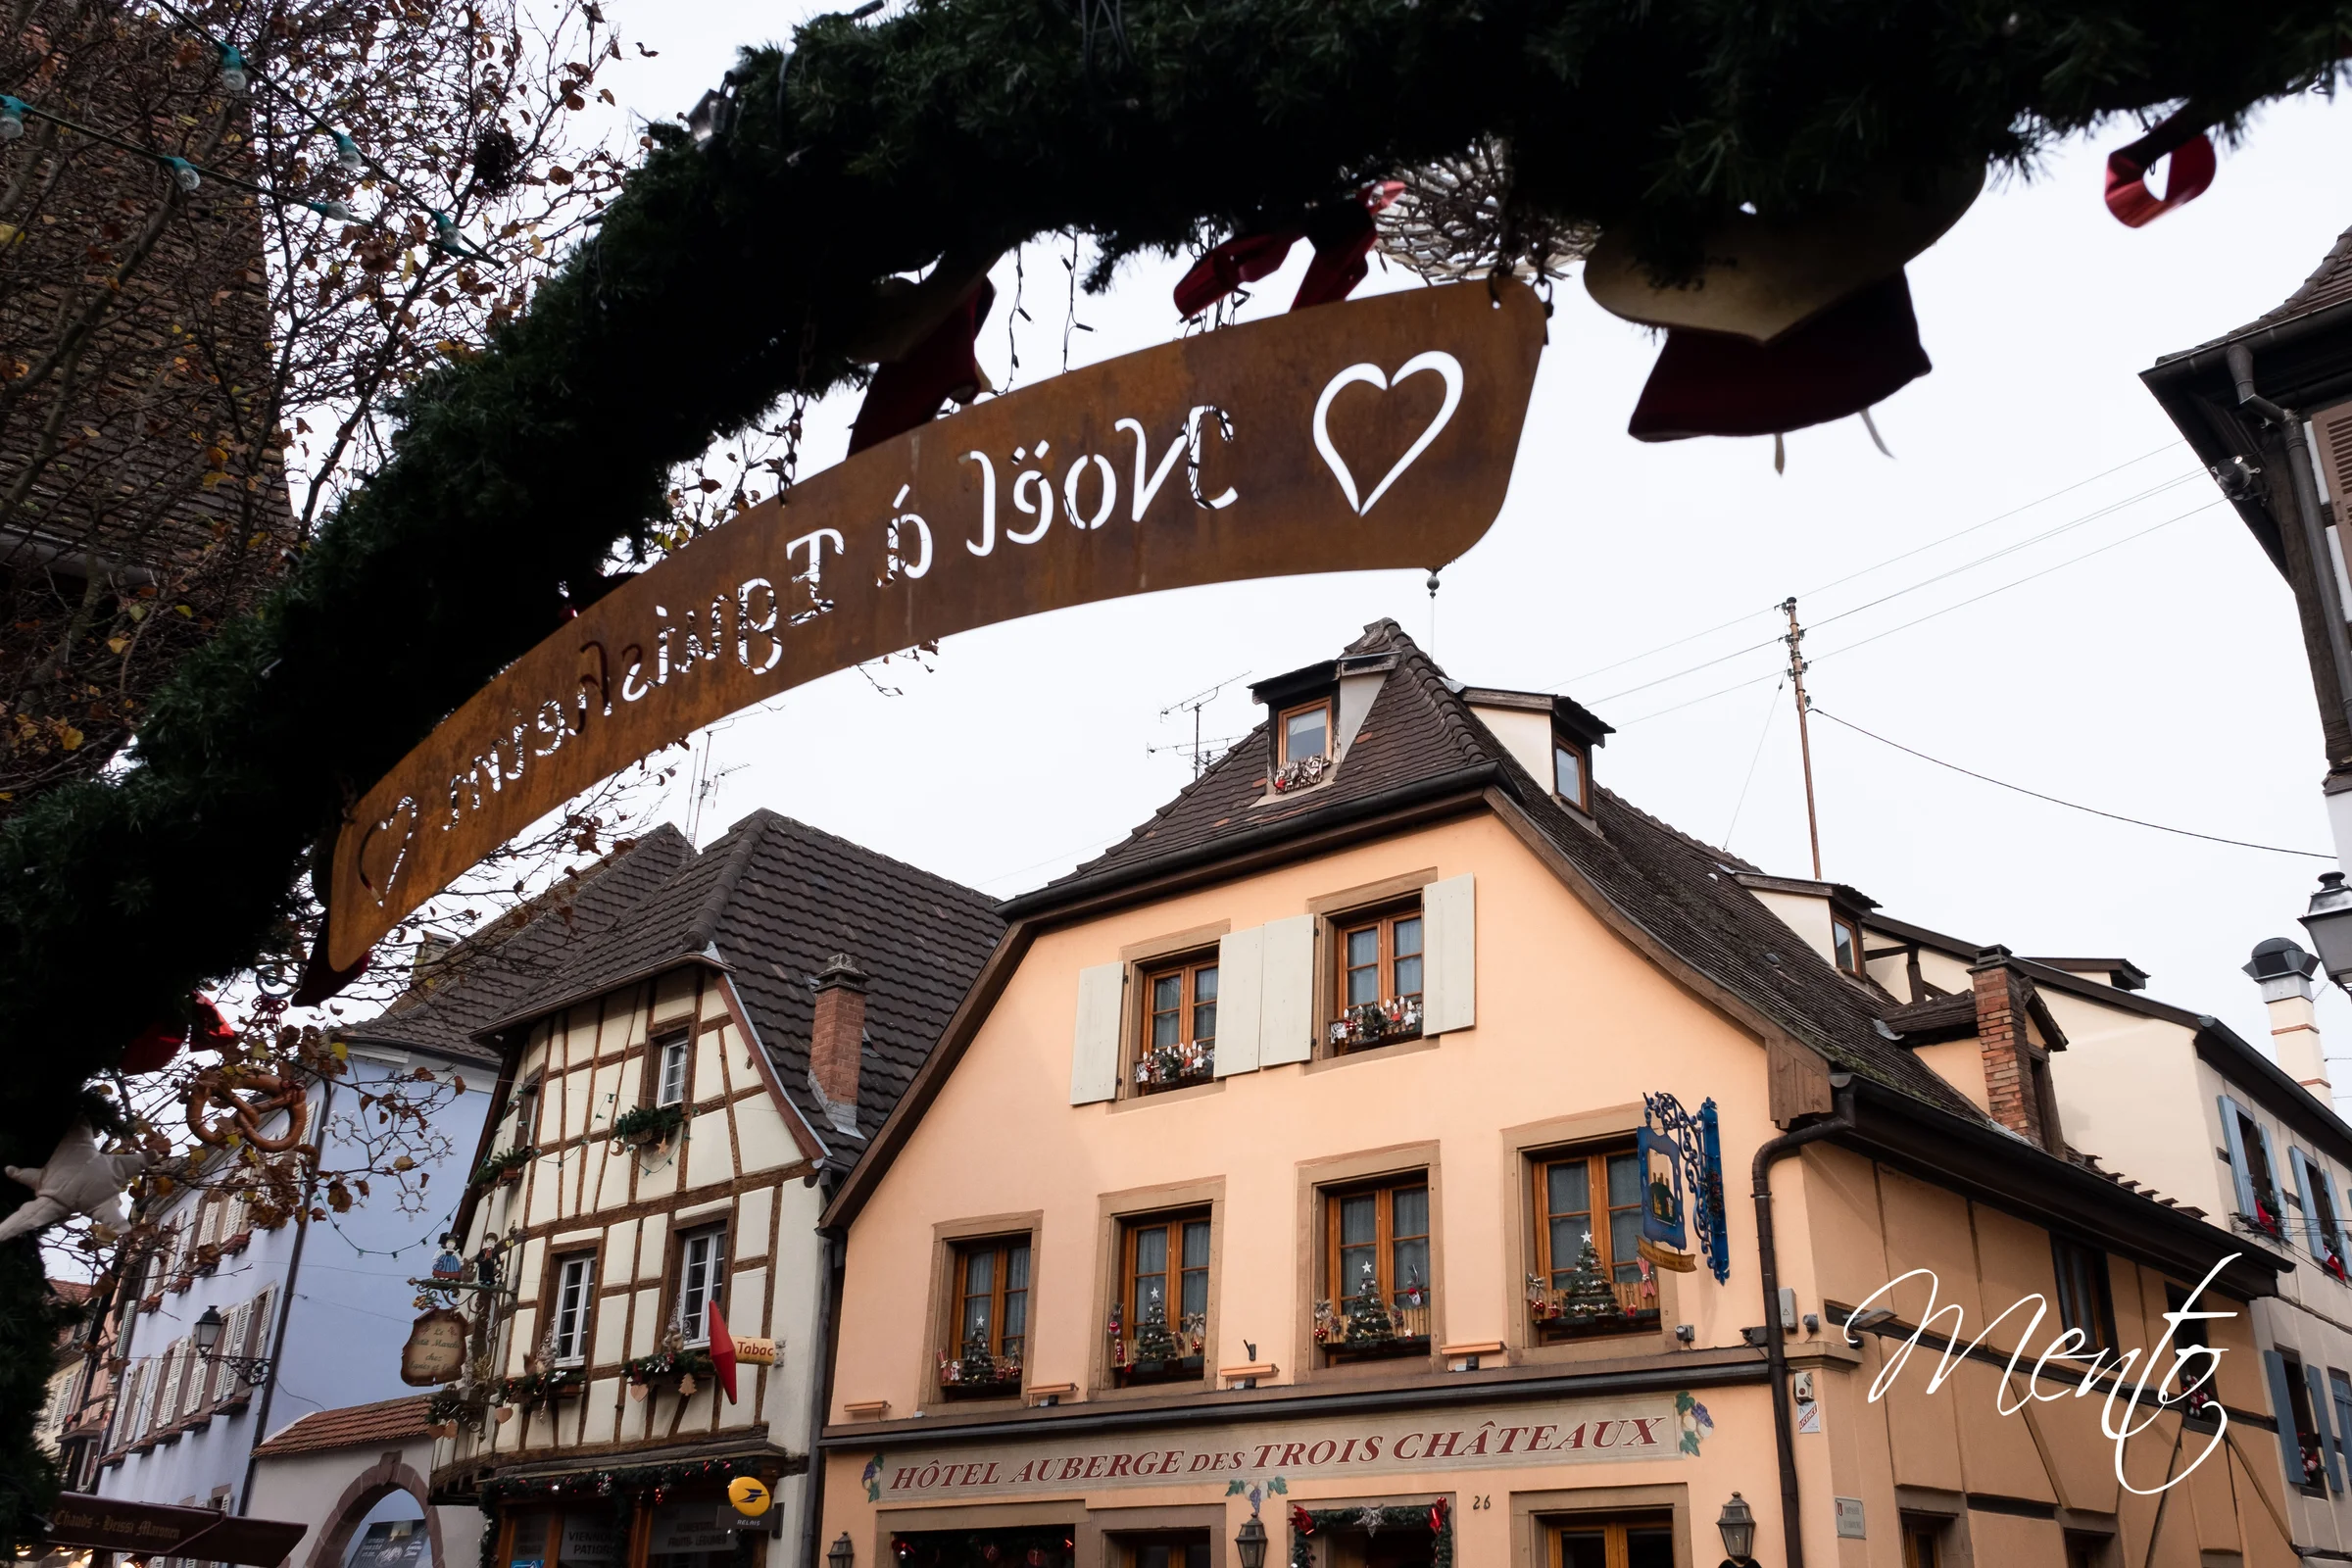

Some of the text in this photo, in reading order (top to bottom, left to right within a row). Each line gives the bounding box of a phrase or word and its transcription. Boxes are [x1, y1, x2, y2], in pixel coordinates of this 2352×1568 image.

[737, 1341, 774, 1356] Tabac
[888, 1417, 1668, 1491] HÔTEL AUBERGE DES TROIS CHÂTEAUX
[1473, 1494, 1491, 1510] 26
